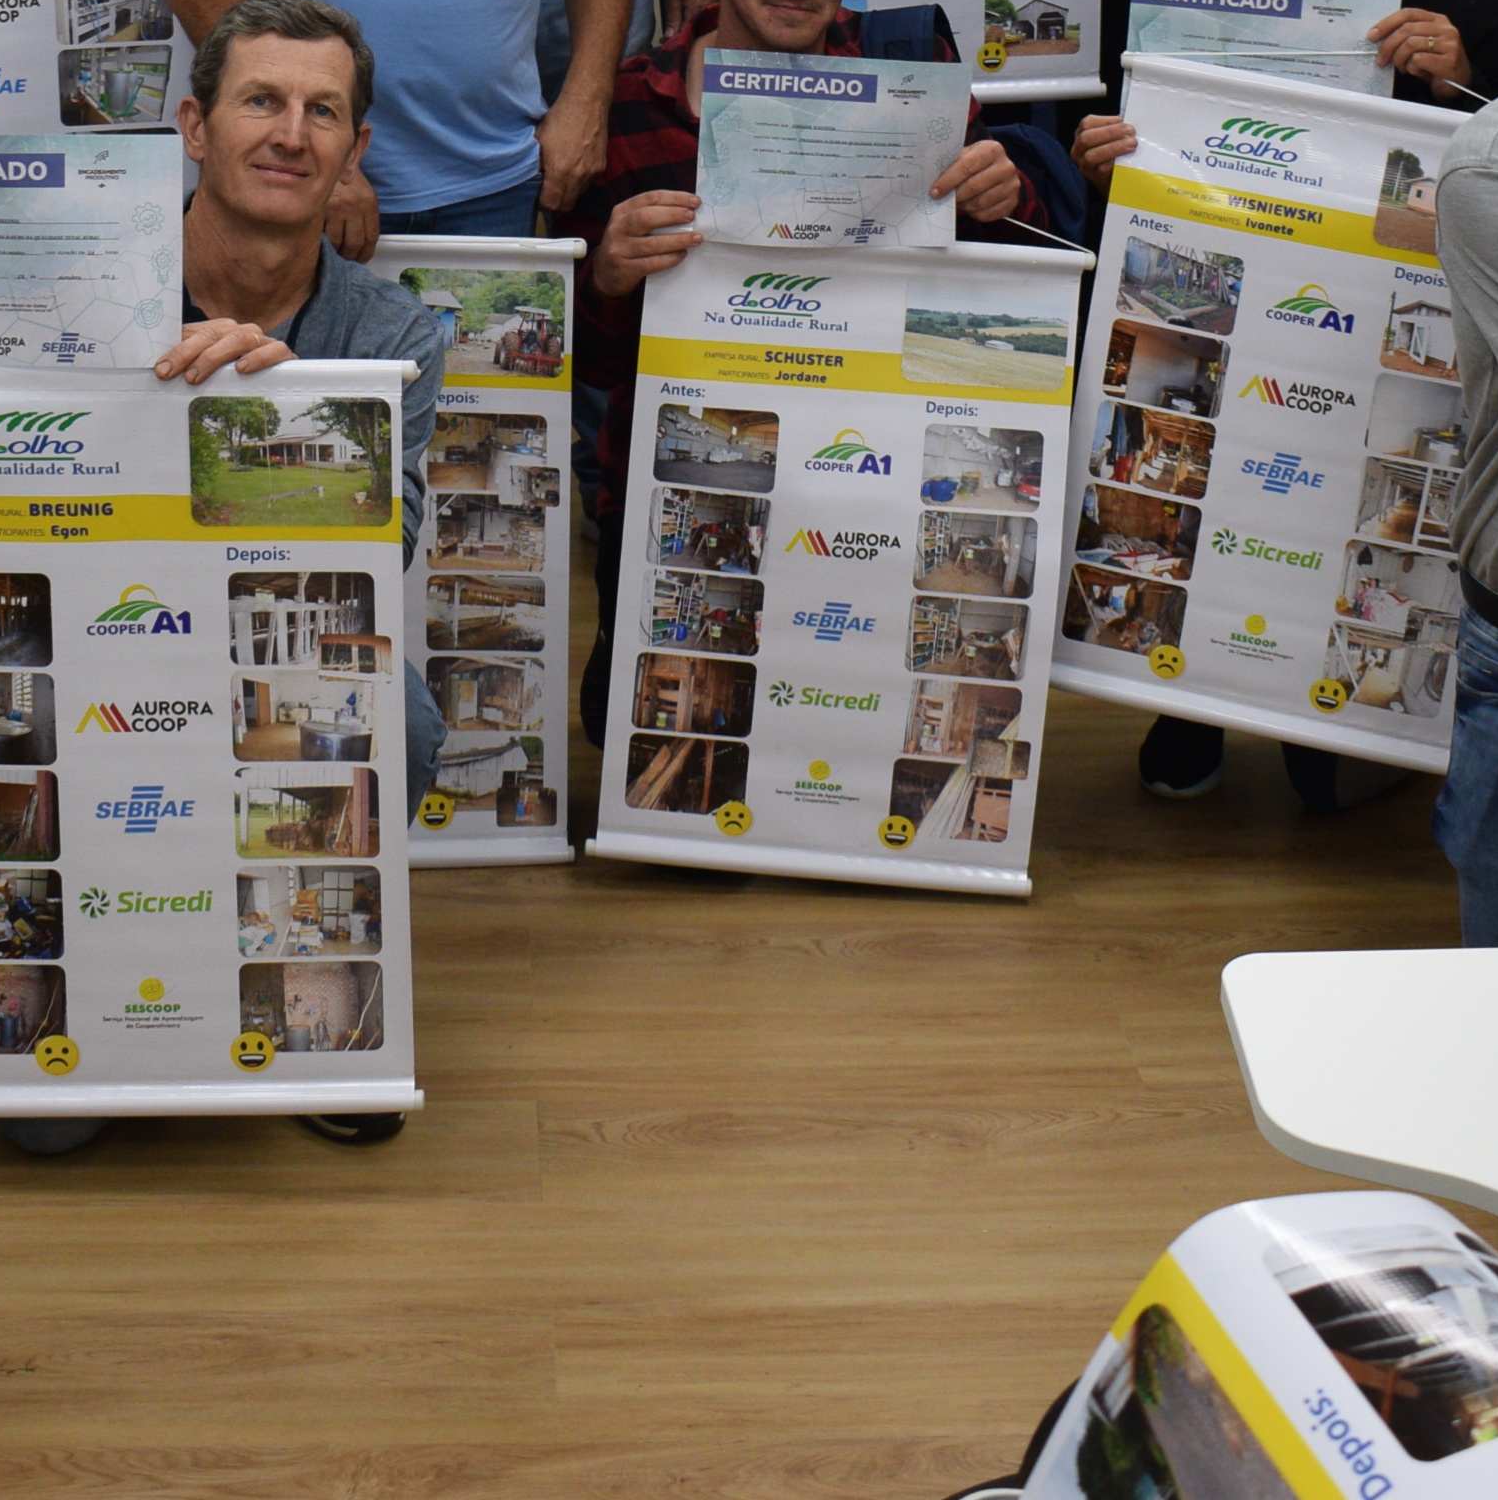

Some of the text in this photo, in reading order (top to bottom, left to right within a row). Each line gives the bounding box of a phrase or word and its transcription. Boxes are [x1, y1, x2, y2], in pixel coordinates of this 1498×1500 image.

[719, 71, 863, 97] CERTIFICADO
[1179, 149, 1324, 188] Na Qualidade Rural
[1227, 193, 1324, 225] WISNIEWSKI
[794, 224, 832, 233] AURORA
[843, 226, 887, 237] SEBRAE
[1129, 213, 1174, 235] Antes:
[1245, 218, 1294, 237] Ivonete
[793, 232, 820, 240] COOP
[703, 311, 849, 333] Na Qualidade Rural
[1265, 308, 1356, 335] COOPER A1
[41, 342, 96, 354] SEBRAE
[764, 350, 844, 368] SCHUSTER
[774, 369, 828, 384] Jordane
[659, 381, 706, 399] Antes:
[1287, 381, 1356, 408] AURORA
[925, 400, 979, 418] Depois:
[1285, 395, 1333, 416] COOP
[72, 461, 121, 476] Rural
[804, 453, 892, 476] COOPER A1
[1240, 457, 1326, 490] SEBRAE
[28, 502, 114, 518] BREUNIG
[50, 524, 89, 540] Egon
[832, 531, 902, 549] AURORA
[225, 545, 292, 564] Depois:
[832, 545, 879, 561] COOP
[1240, 536, 1324, 571] Sicredi
[85, 610, 191, 637] COOPER A1
[792, 610, 877, 633] SEBRAE
[131, 700, 214, 717] AURORA
[799, 686, 880, 712] Sicredi
[131, 716, 188, 733] COOP
[94, 800, 195, 820] SEBRAE
[116, 890, 213, 914] Sicredi
[124, 1004, 181, 1013] SESCOOP
